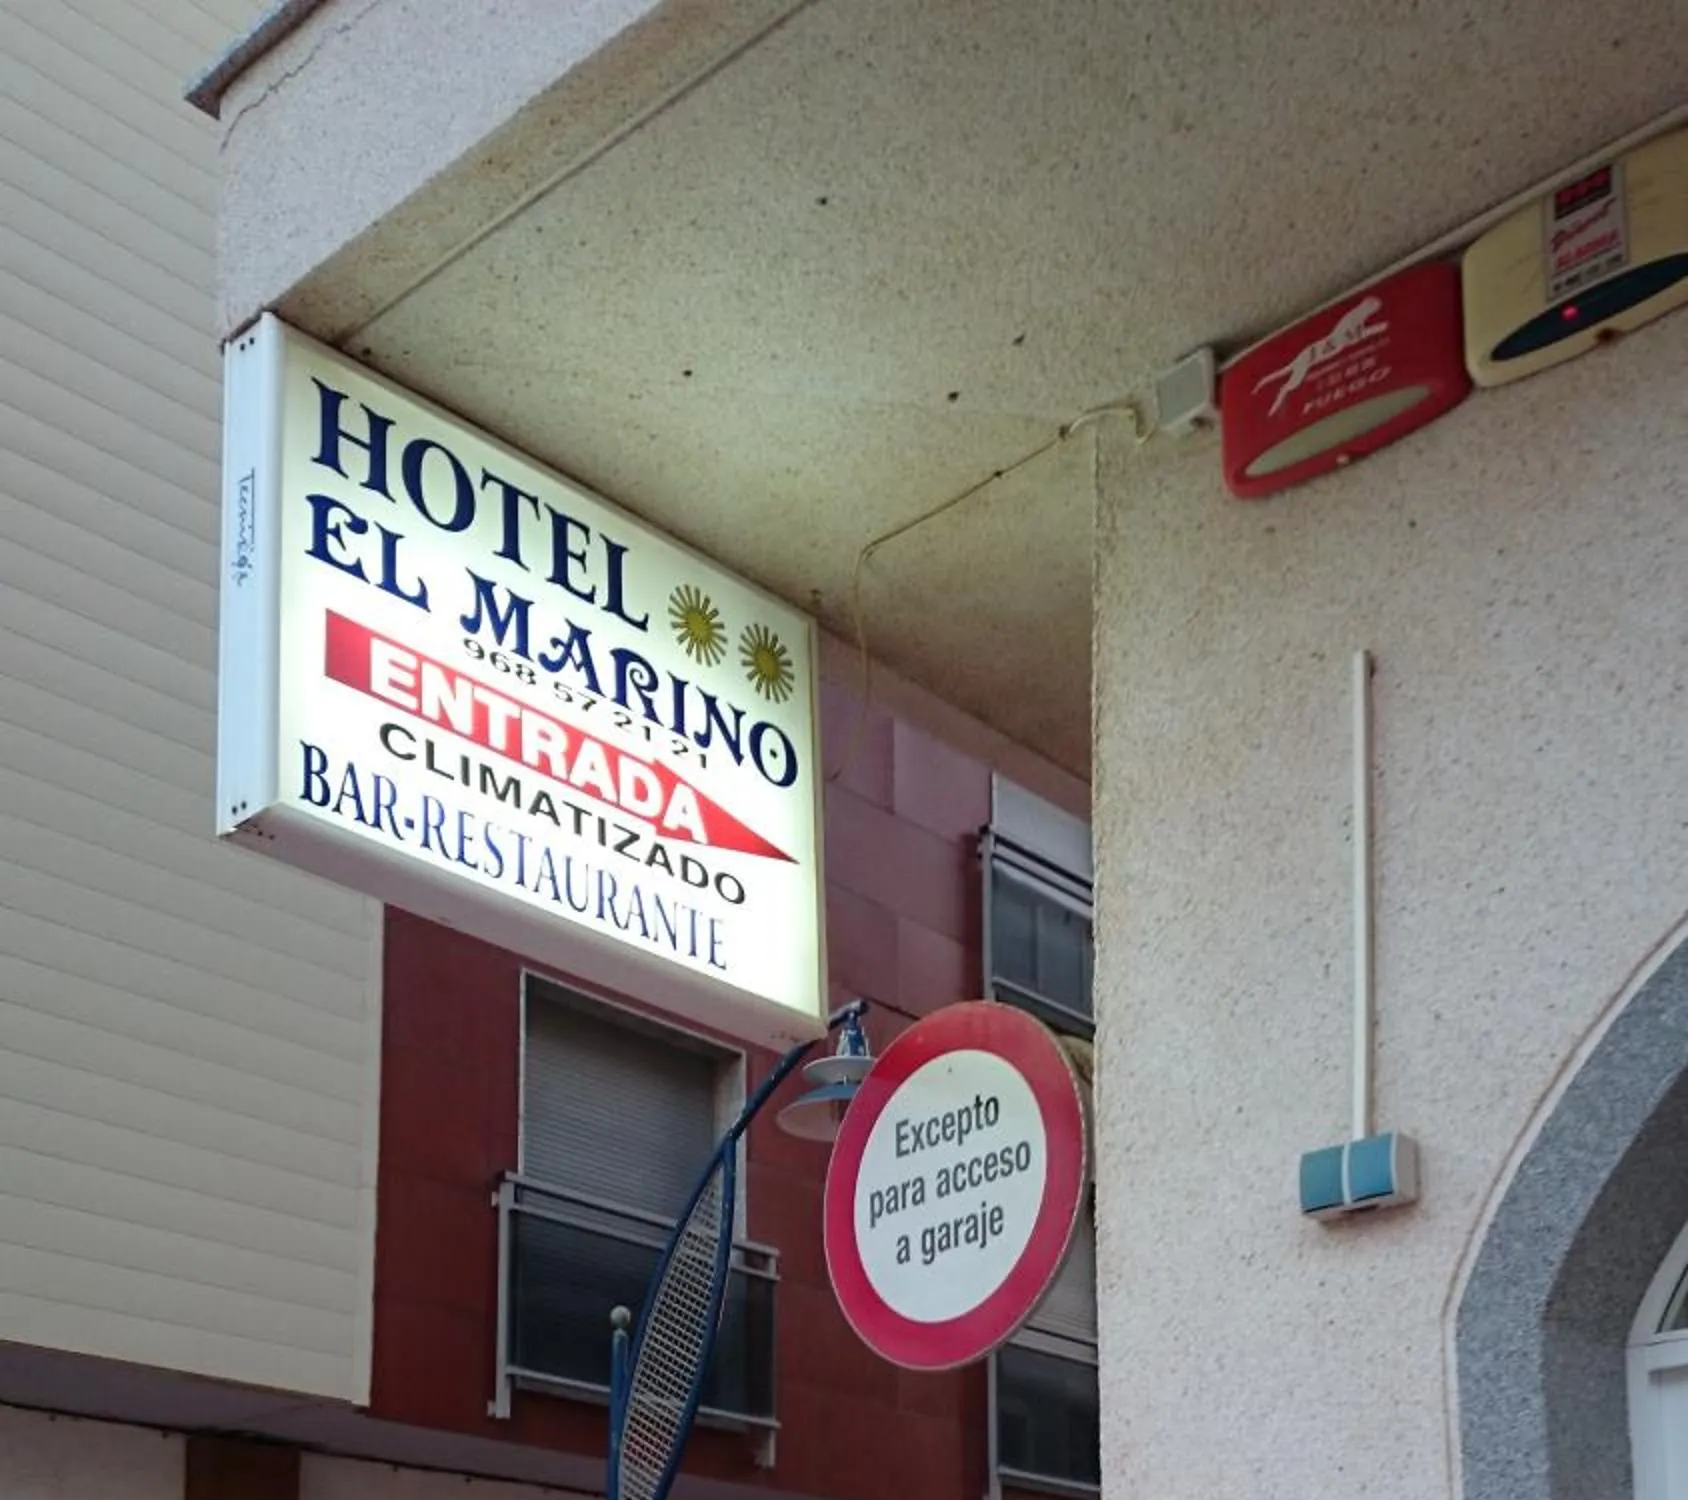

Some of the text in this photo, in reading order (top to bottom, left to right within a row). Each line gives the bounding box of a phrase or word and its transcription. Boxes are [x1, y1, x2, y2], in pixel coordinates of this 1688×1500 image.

[310, 376, 650, 633] HOTEL
[304, 494, 799, 789] EL MARINO
[463, 637, 708, 769] 968 57 21 21
[370, 637, 711, 846] ENTRADA
[379, 722, 747, 905] CLIMATIZADO
[869, 1139, 1032, 1229] para acceso
[895, 1094, 1001, 1159] Excepto
[896, 1201, 1005, 1265] a garaje
